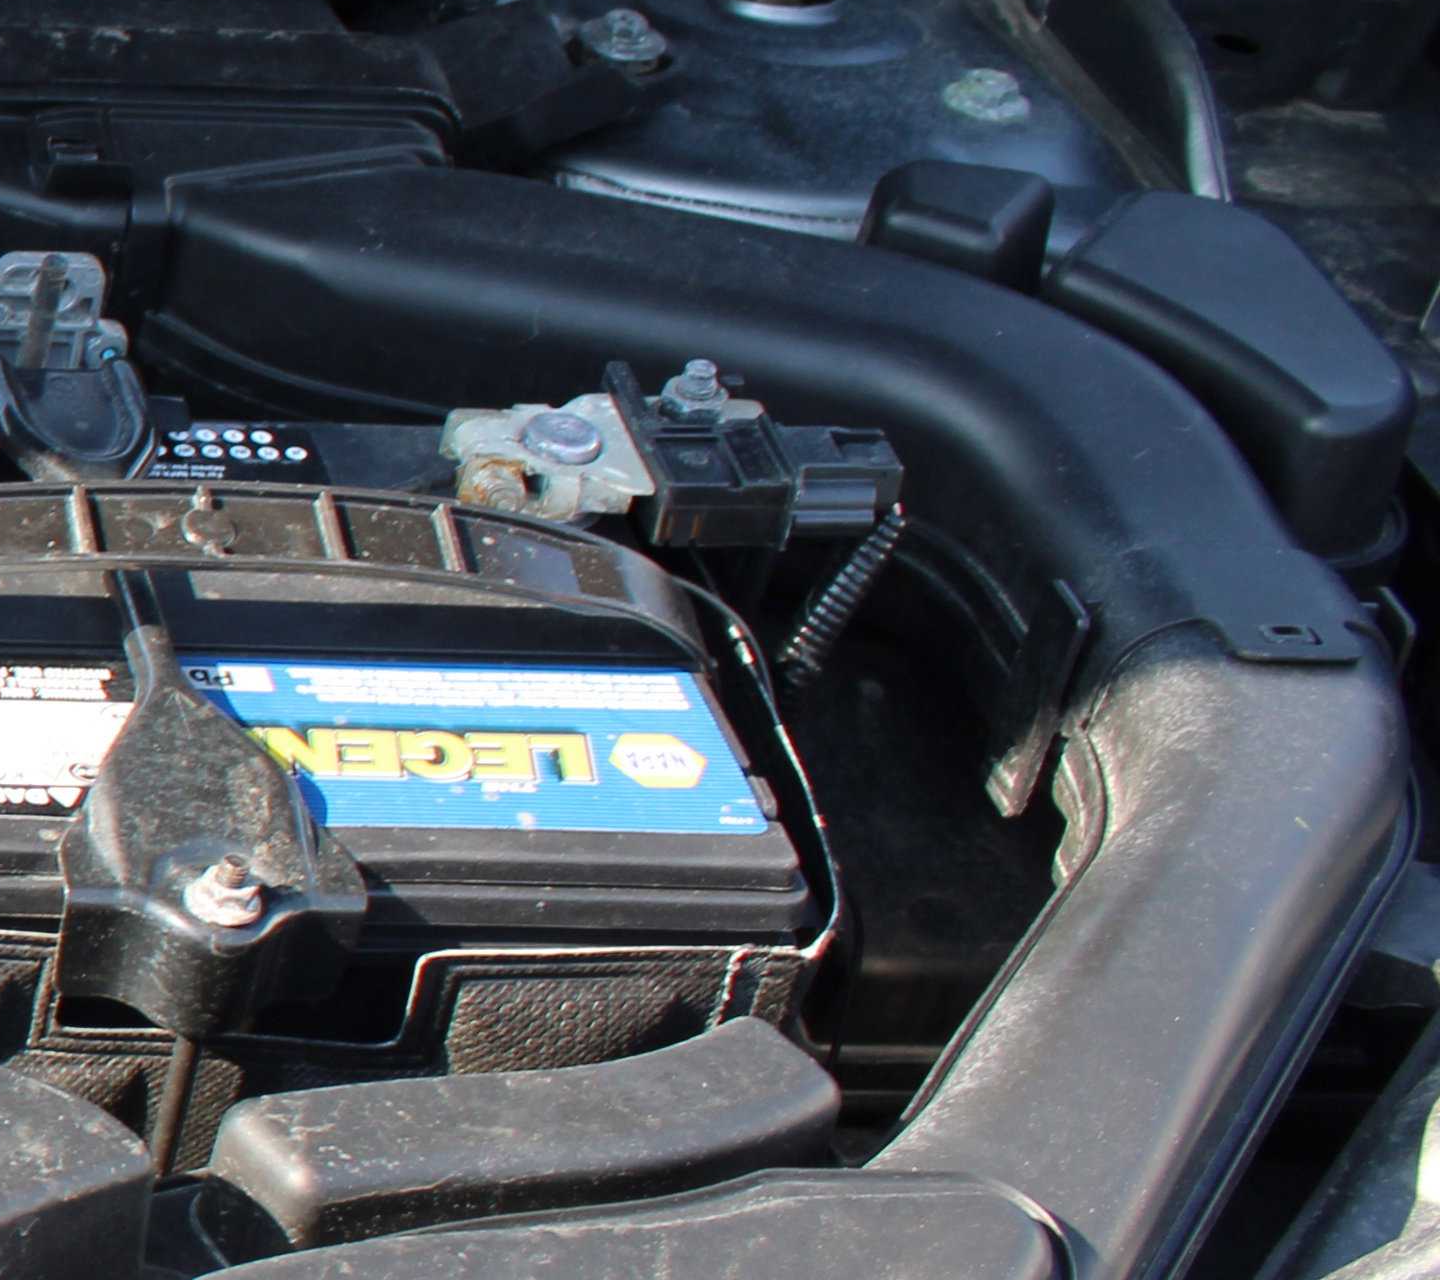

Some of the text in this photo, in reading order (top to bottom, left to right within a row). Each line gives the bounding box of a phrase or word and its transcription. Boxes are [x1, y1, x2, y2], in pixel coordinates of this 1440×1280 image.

[189, 667, 236, 687] Pb
[244, 724, 597, 785] LEGEN
[622, 749, 689, 773] NAPA
